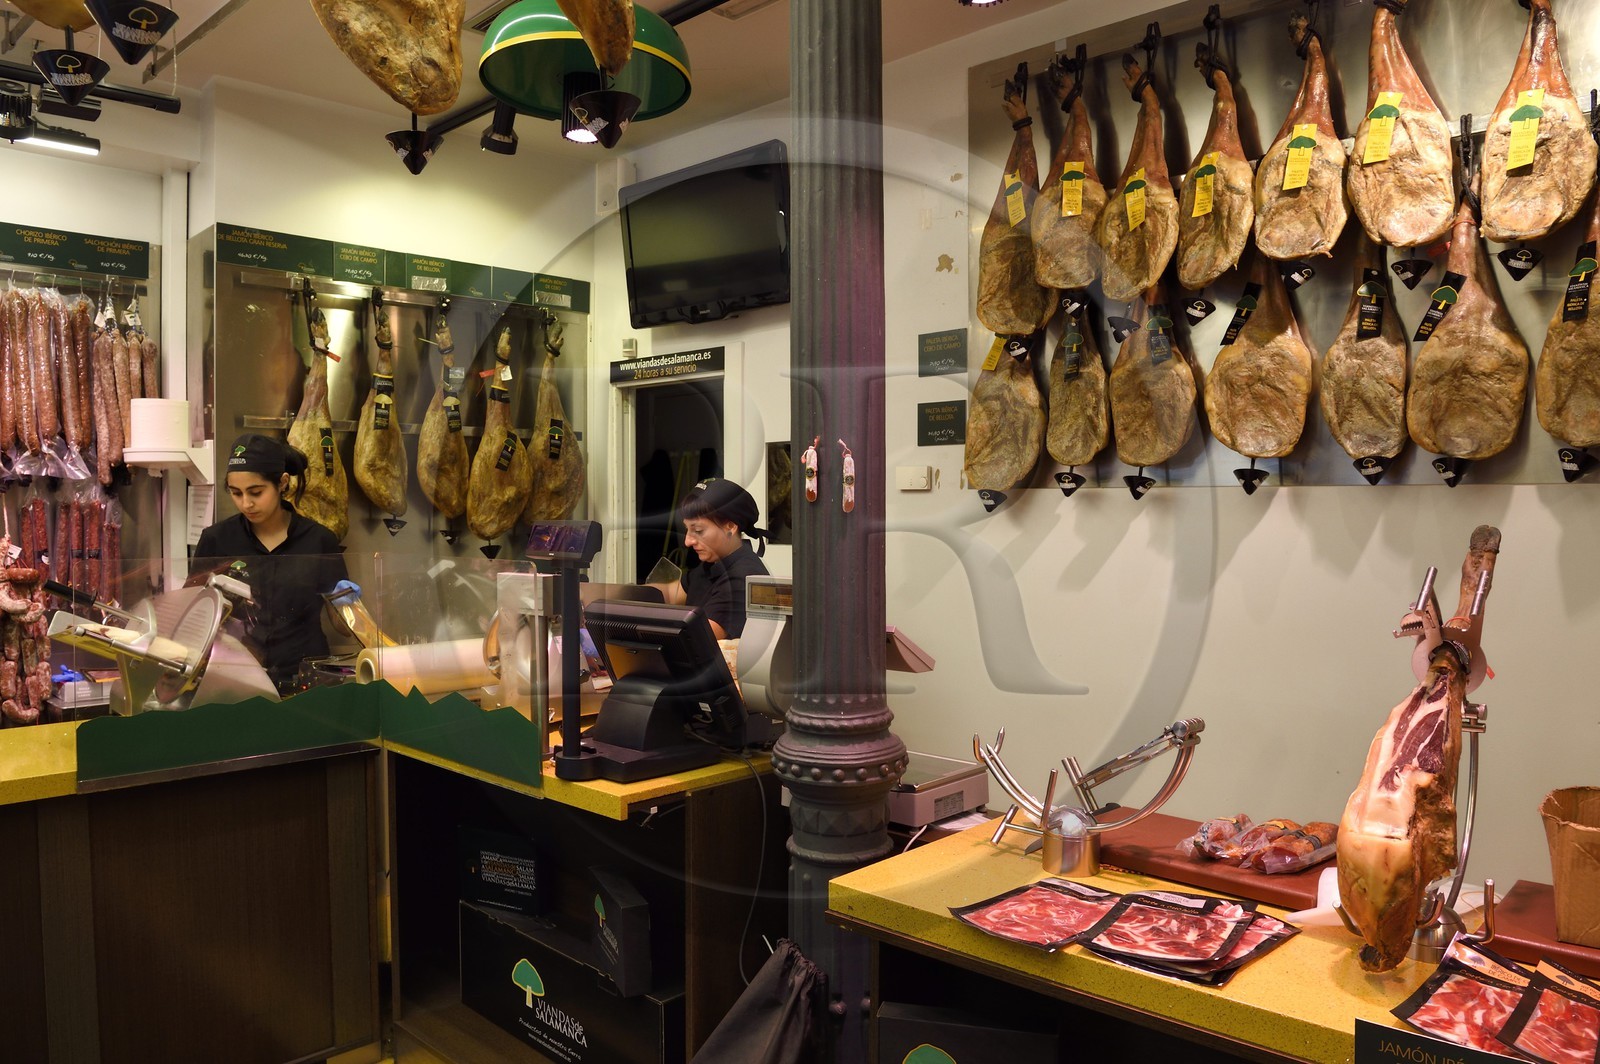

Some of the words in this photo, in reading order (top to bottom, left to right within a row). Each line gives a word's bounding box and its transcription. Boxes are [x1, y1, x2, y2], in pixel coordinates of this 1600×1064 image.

[16, 229, 44, 238] CHORIZO
[44, 232, 67, 241] IBÉRICO
[34, 238, 60, 246] PRIMERA
[84, 238, 122, 248] SALCHICHÓN
[249, 238, 265, 246] GRAN
[106, 247, 130, 255] PRIMERA
[360, 256, 377, 264] CAMPO
[620, 350, 712, 370] www.viandasdesalamanca.es
[634, 369, 641, 380] 24
[642, 368, 659, 378] horas
[660, 368, 664, 376] a
[665, 367, 673, 376] su
[674, 364, 697, 374] servicio
[536, 1008, 588, 1048] SALAMANCA
[1379, 1040, 1437, 1064] JAMÓN
